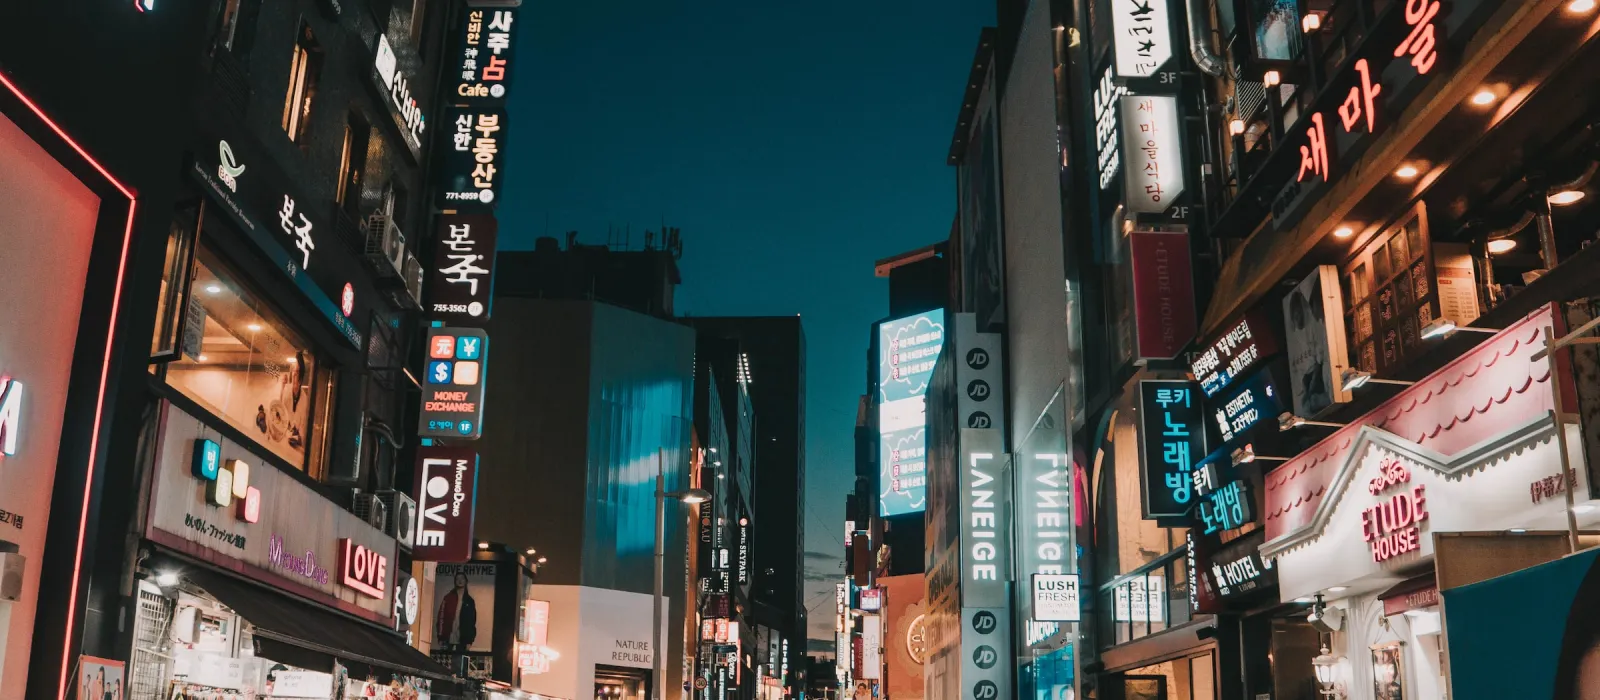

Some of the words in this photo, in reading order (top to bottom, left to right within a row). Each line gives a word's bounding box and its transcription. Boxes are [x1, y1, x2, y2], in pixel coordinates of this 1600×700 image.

[467, 10, 483, 45] 신비안
[458, 83, 489, 97] Cafe
[1159, 72, 1177, 84] 3F
[1297, 0, 1440, 182] 새마을
[393, 70, 425, 148] 신비안
[454, 114, 473, 151] 신한
[472, 114, 500, 188] 부동산
[1137, 99, 1164, 203] 새마을식당
[445, 191, 478, 200] 771-8959
[1171, 206, 1189, 219] 2F
[279, 194, 314, 270] 본죽
[438, 223, 489, 296] 본죽
[1155, 248, 1171, 294] ETUDE
[433, 303, 467, 313] 755-3562
[1160, 297, 1175, 343] HOUSE
[969, 353, 986, 366] JD
[434, 391, 468, 401] MONEY
[970, 384, 987, 397] JD
[1155, 388, 1191, 408] 루키
[1225, 388, 1254, 418] ESTHETIC
[425, 402, 475, 412] EXCHANGE
[460, 423, 471, 431] 1F
[971, 416, 989, 428] JD
[1162, 411, 1193, 503] 노래방
[1192, 463, 1213, 497] 루키
[416, 458, 452, 547] LOVE
[1200, 481, 1243, 535] 노래방
[1361, 484, 1430, 542] ETUDE
[970, 453, 997, 580] LANEIGE
[1371, 527, 1420, 562] HOUSE
[344, 537, 387, 600] LOVE
[739, 545, 747, 582] SKYPARK
[1224, 555, 1260, 586] HOTEL
[1038, 581, 1075, 591] LUSH
[1038, 592, 1076, 601] FRESH
[1408, 590, 1431, 607] ETUDE
[975, 616, 993, 629] JD
[612, 652, 650, 663] REPUBLIC
[615, 639, 649, 651] NATURE
[976, 651, 994, 664] JD
[977, 685, 996, 698] JD
